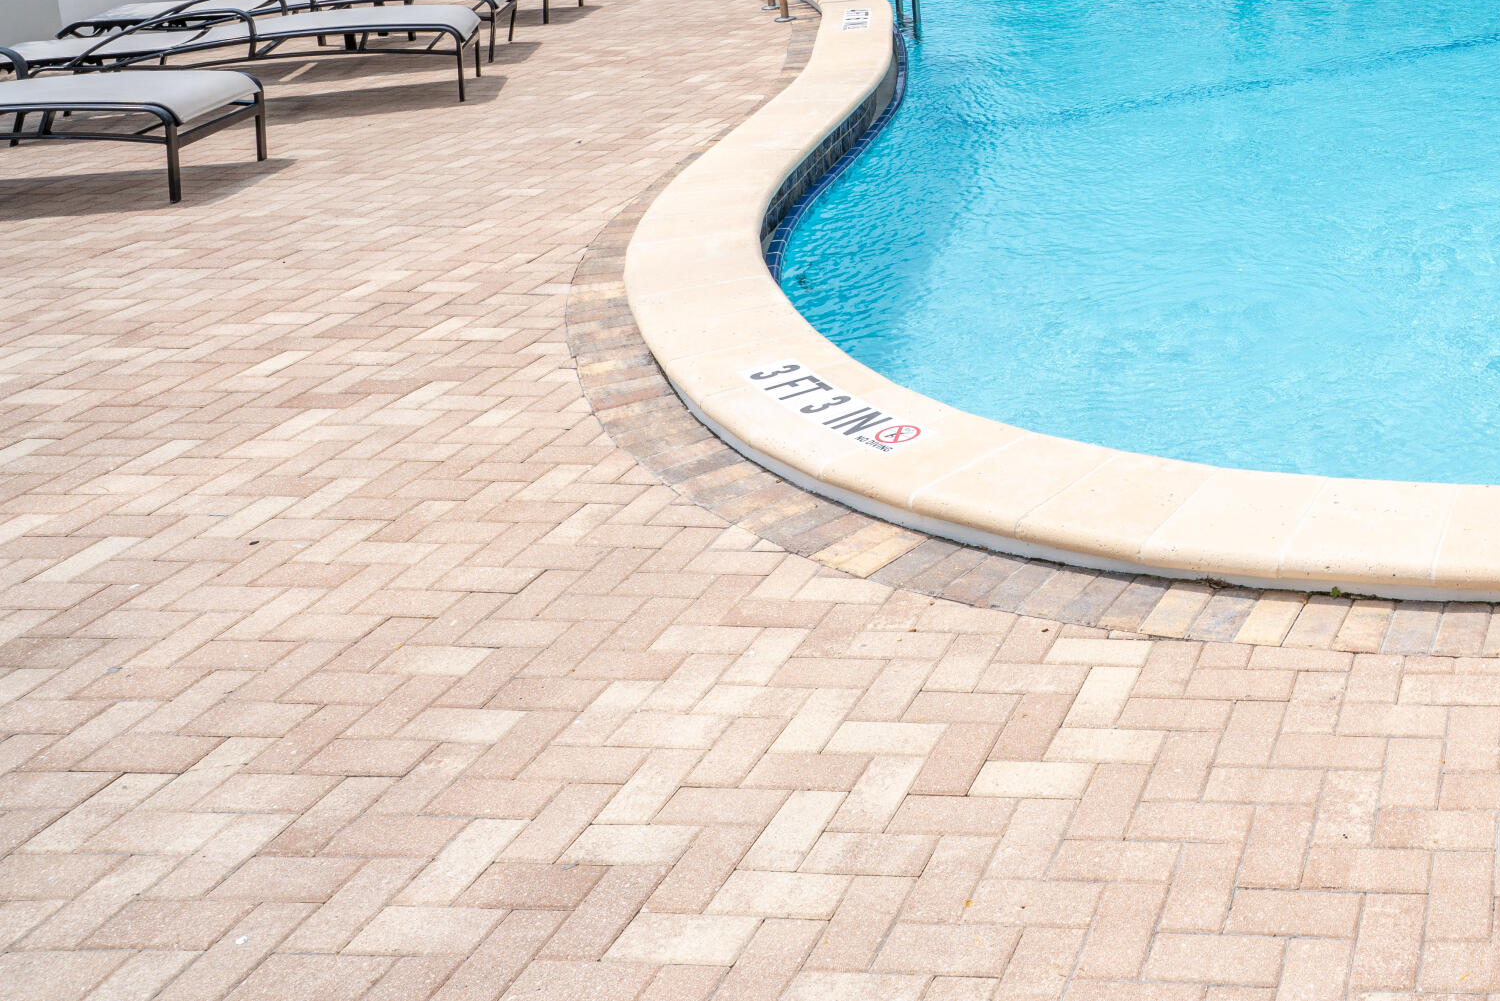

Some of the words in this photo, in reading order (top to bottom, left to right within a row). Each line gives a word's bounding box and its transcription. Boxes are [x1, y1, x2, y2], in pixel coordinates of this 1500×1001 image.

[750, 364, 801, 380] 3
[764, 375, 833, 400] FT
[800, 395, 852, 414] 3
[822, 406, 893, 436] IN
[854, 435, 870, 443] NO
[865, 439, 894, 453] DIVING
